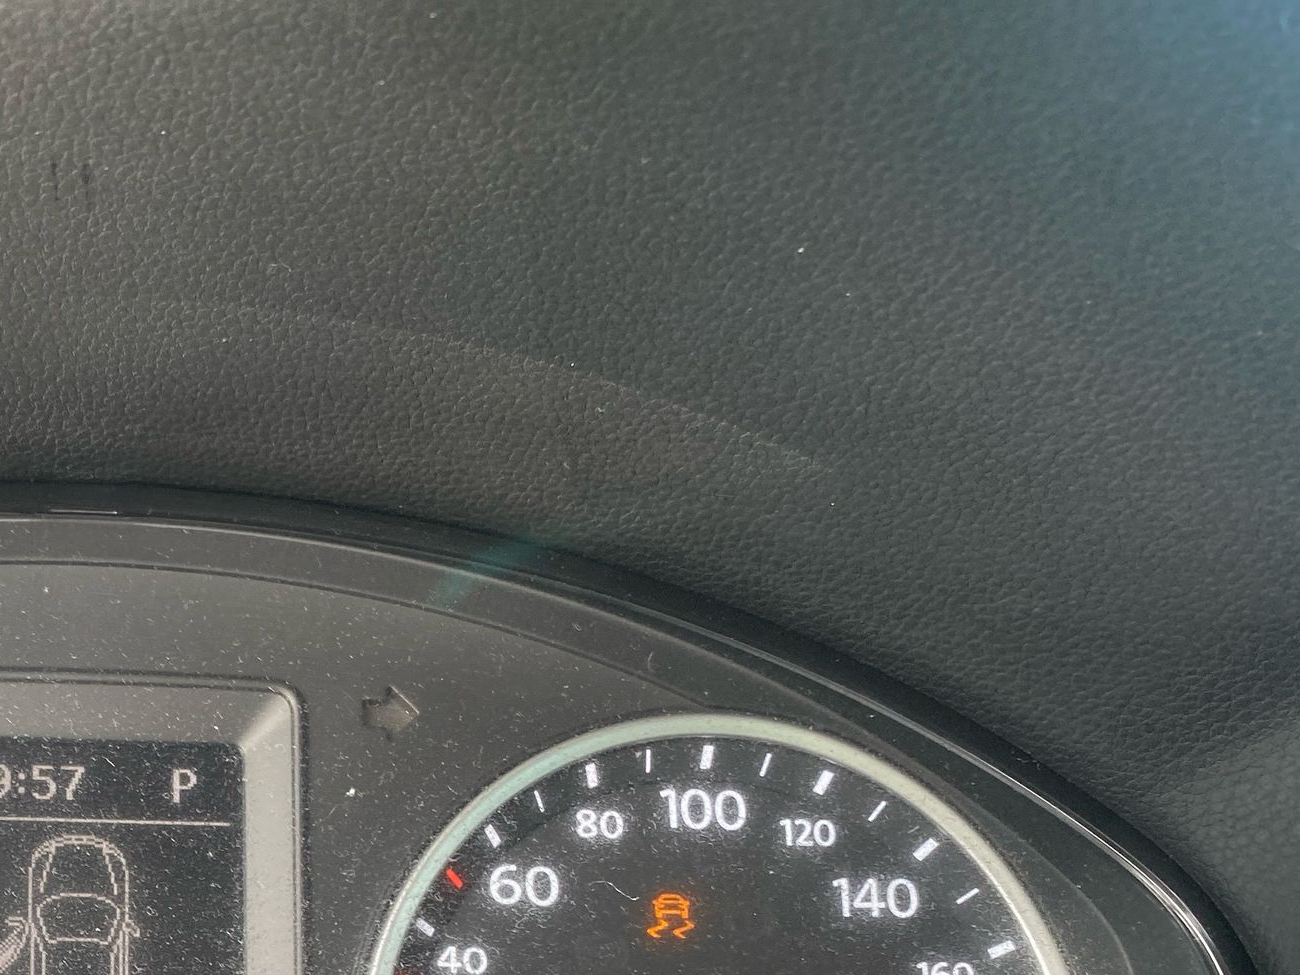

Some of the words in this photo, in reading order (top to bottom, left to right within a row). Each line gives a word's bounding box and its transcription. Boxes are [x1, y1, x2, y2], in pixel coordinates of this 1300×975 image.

[173, 769, 197, 803] P
[576, 811, 623, 840] 80
[660, 789, 746, 831] 100
[780, 819, 836, 847] 120
[489, 866, 559, 907] 60
[832, 878, 919, 918] 140
[438, 946, 487, 975] 40
